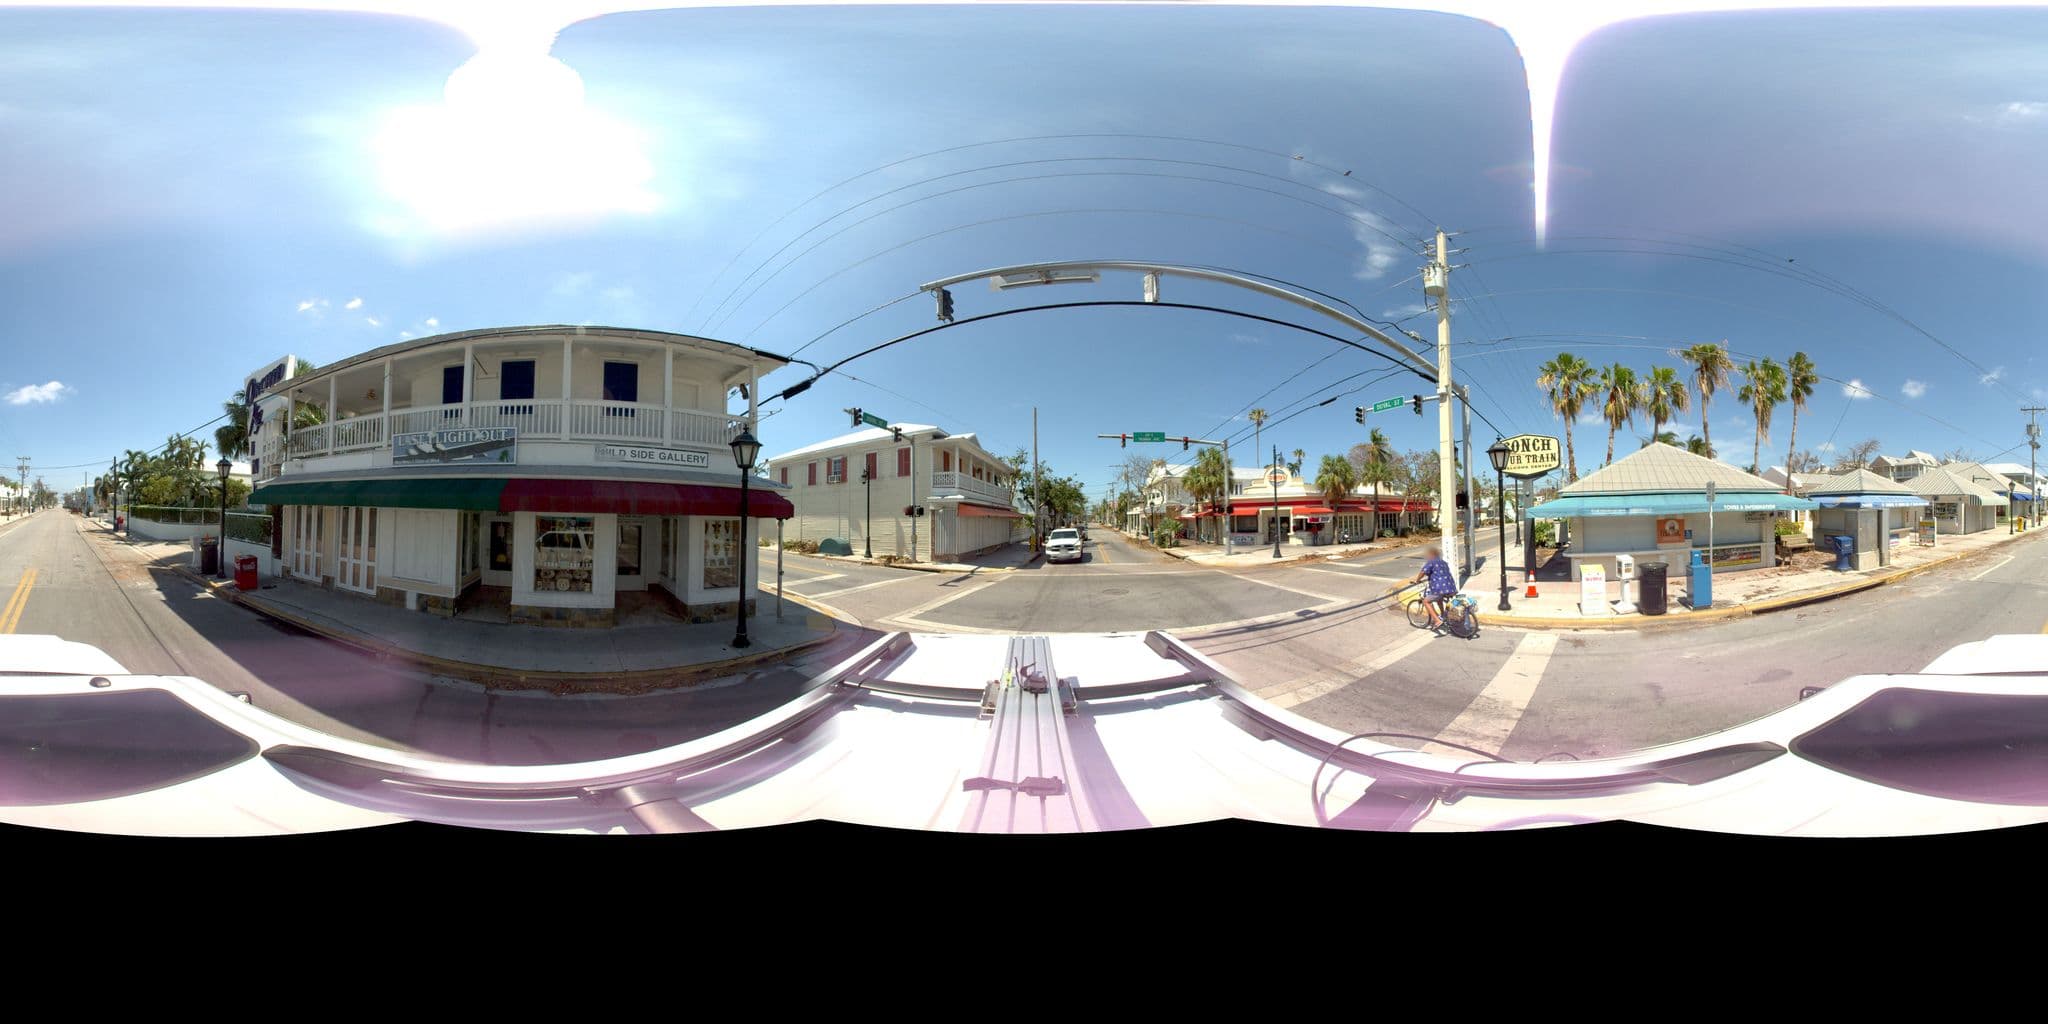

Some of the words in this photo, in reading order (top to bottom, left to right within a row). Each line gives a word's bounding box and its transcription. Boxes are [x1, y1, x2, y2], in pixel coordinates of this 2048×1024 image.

[480, 429, 508, 441] OUT
[630, 449, 655, 459] SIDE
[658, 452, 706, 464] GALLERY
[1525, 453, 1556, 463] TRAIN
